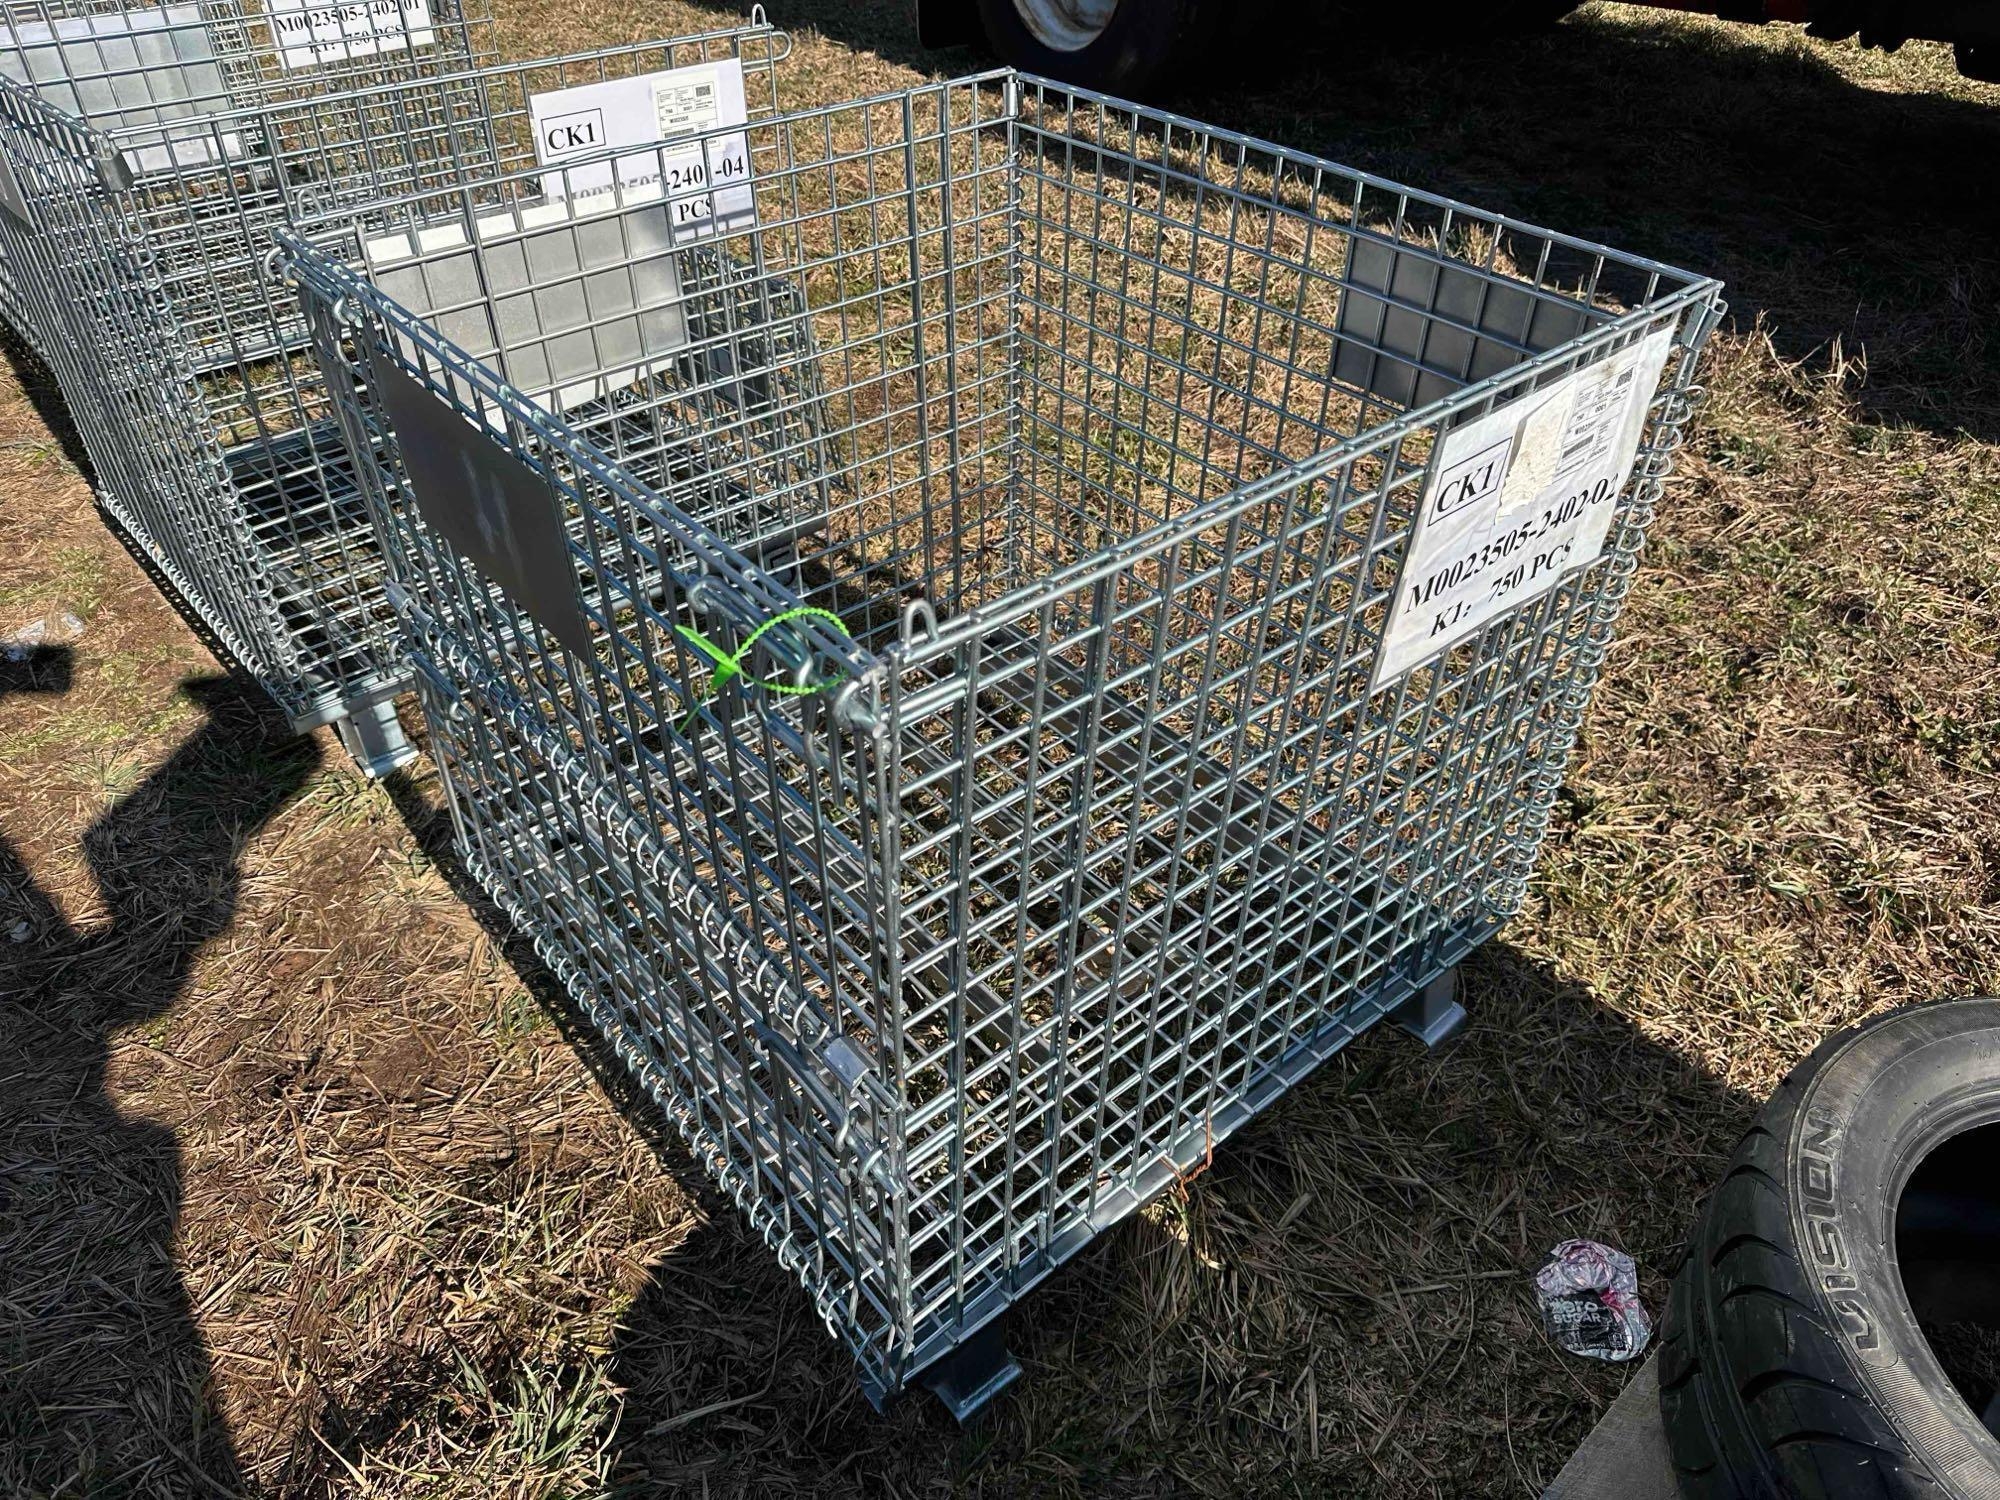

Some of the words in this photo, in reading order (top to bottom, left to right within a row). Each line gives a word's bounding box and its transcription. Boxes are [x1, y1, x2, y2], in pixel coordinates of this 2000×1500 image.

[277, 0, 421, 34] M0023505-40201
[547, 121, 597, 151] CK1
[678, 197, 713, 222] PCS
[1437, 461, 1494, 513] CK1
[1404, 472, 1619, 615] M0023505-2402-02
[1429, 600, 1472, 638] K1:
[1488, 564, 1526, 602] 750
[1527, 537, 1575, 581] PCS
[1800, 1105, 1881, 1351] VISION
[1553, 1312, 1601, 1324] SUGAR
